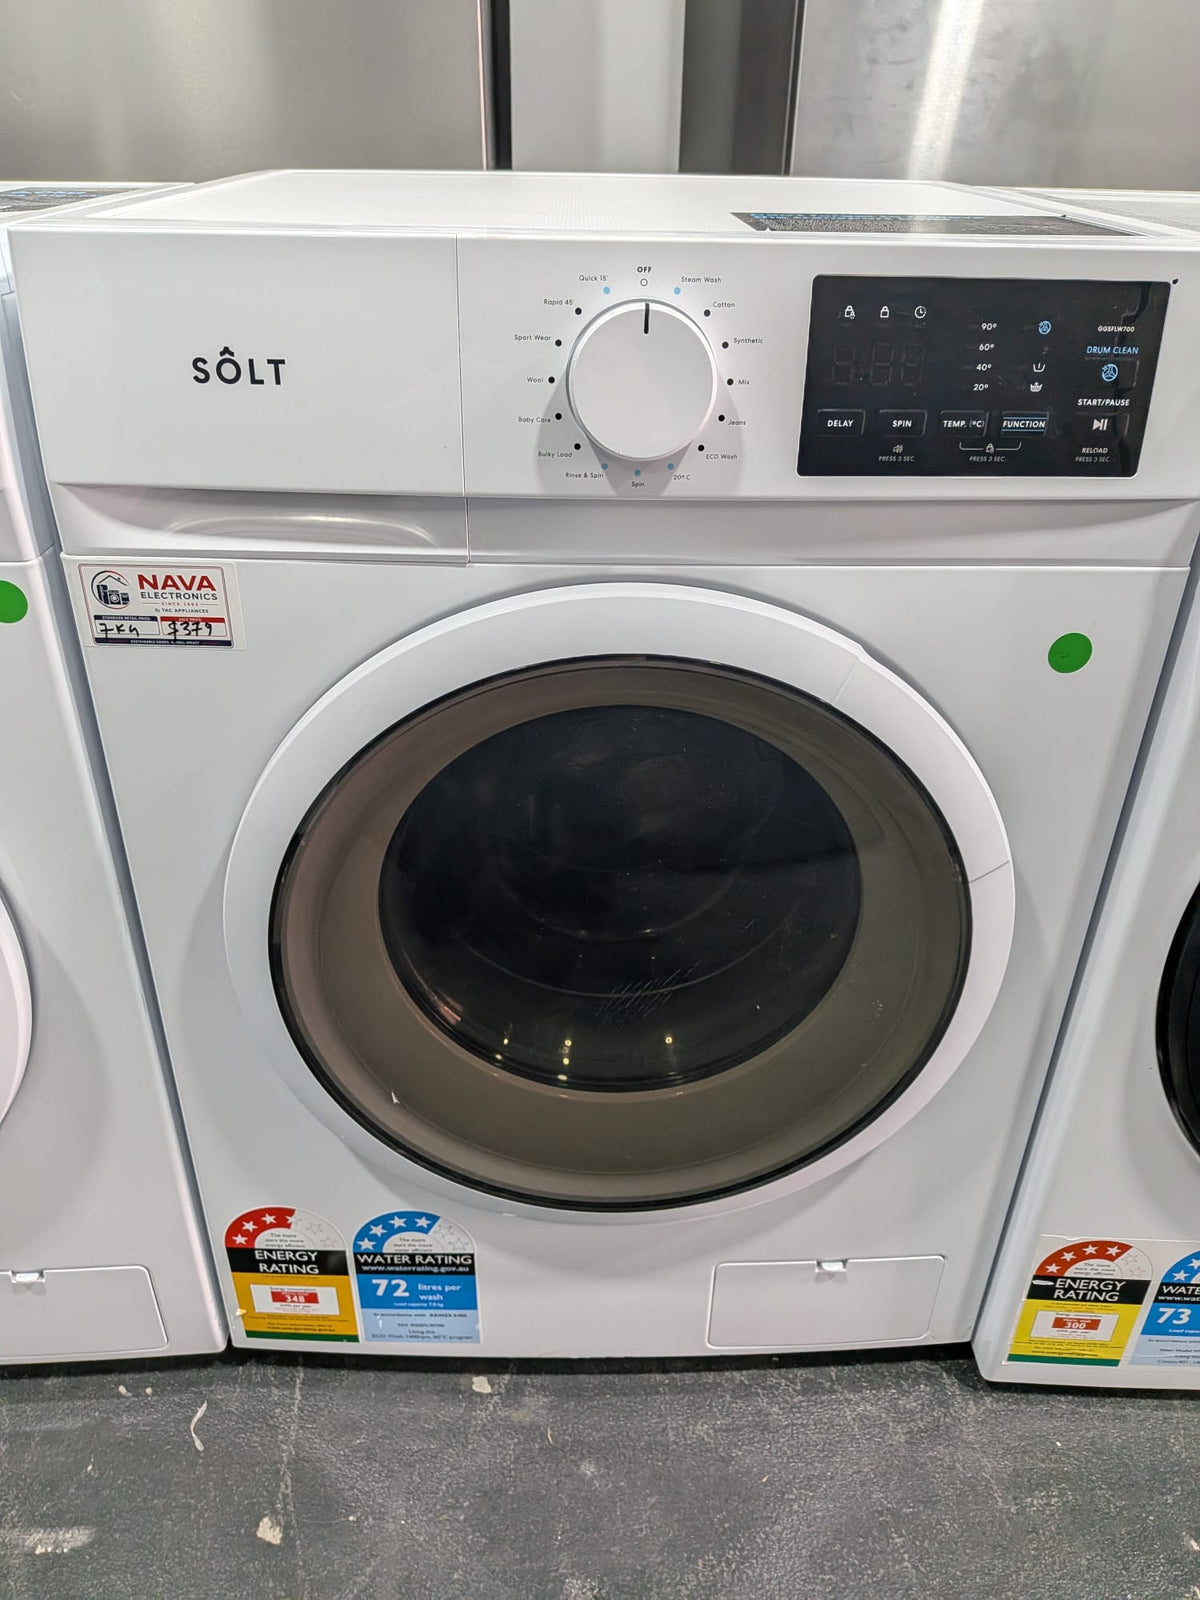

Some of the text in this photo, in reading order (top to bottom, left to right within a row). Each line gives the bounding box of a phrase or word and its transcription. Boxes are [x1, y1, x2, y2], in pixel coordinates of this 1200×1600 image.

[514, 334, 532, 342] Sport
[733, 337, 764, 345] Synthetic
[1086, 346, 1111, 354] DRUM
[192, 346, 285, 385] SÔLT
[518, 416, 534, 425] Baby
[827, 419, 854, 428] DELAY
[892, 419, 912, 428] SPIN
[943, 419, 967, 428] TEMP.
[1003, 419, 1046, 429] FUNCTION
[538, 451, 555, 459] Bulky
[590, 472, 603, 480] Spin
[138, 574, 217, 591] NAVA
[141, 592, 218, 600] ELECTRONICS
[167, 621, 213, 640] $379
[255, 1251, 318, 1261] ENERGY
[357, 1255, 472, 1264] WATER RATING
[259, 1264, 319, 1273] RATING
[372, 1279, 409, 1297] 72
[1056, 1279, 1126, 1290] ENERGY
[1054, 1290, 1120, 1301] RATING
[1157, 1307, 1192, 1324] 73
